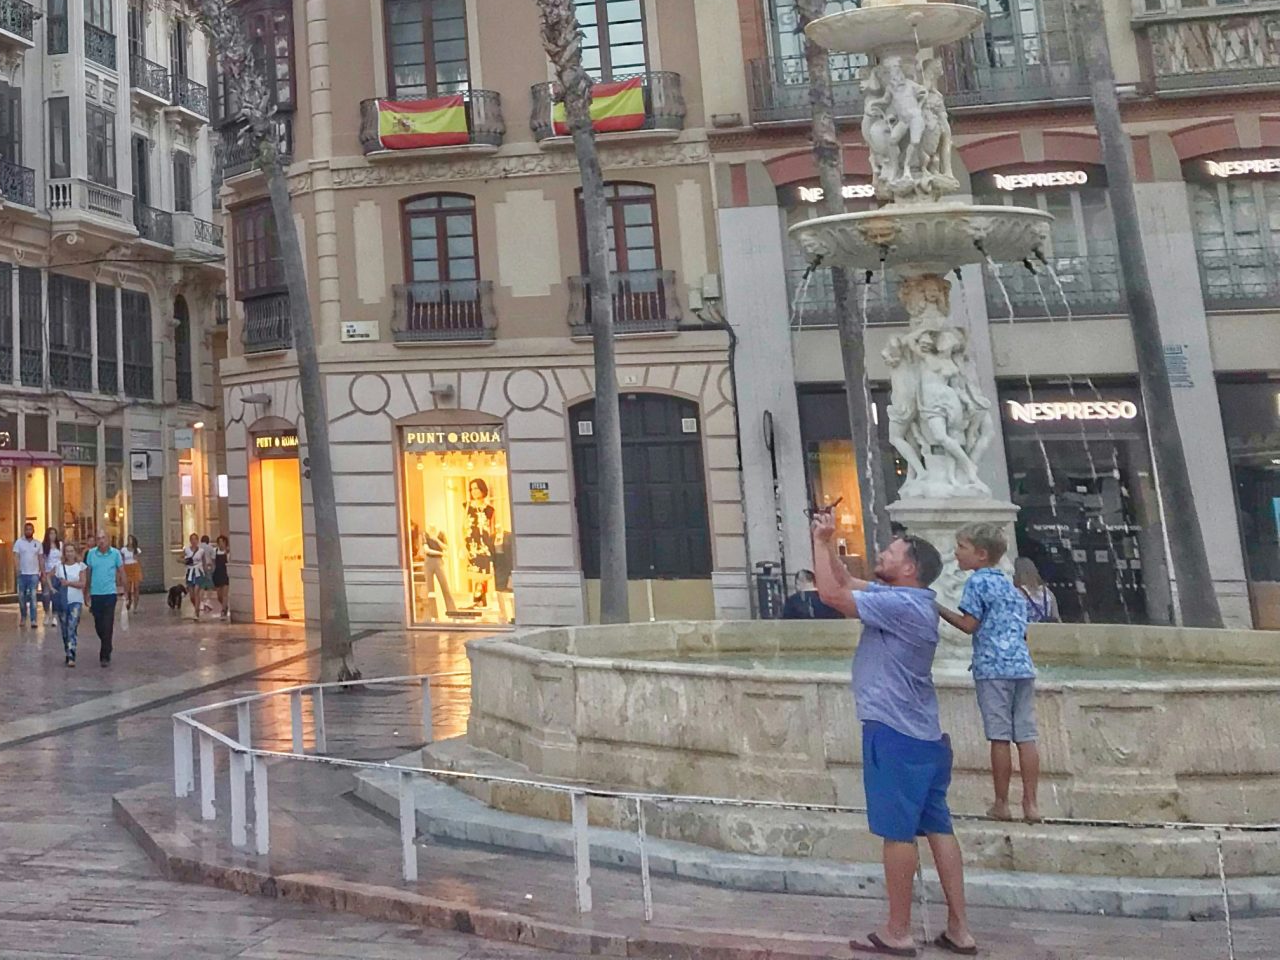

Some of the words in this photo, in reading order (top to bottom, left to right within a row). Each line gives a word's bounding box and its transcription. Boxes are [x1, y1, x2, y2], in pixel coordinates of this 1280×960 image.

[993, 171, 1088, 191] NESPRESSO
[1006, 400, 1137, 424] NESPRESSO
[407, 432, 445, 444] PUNT
[461, 431, 501, 443] ROMA
